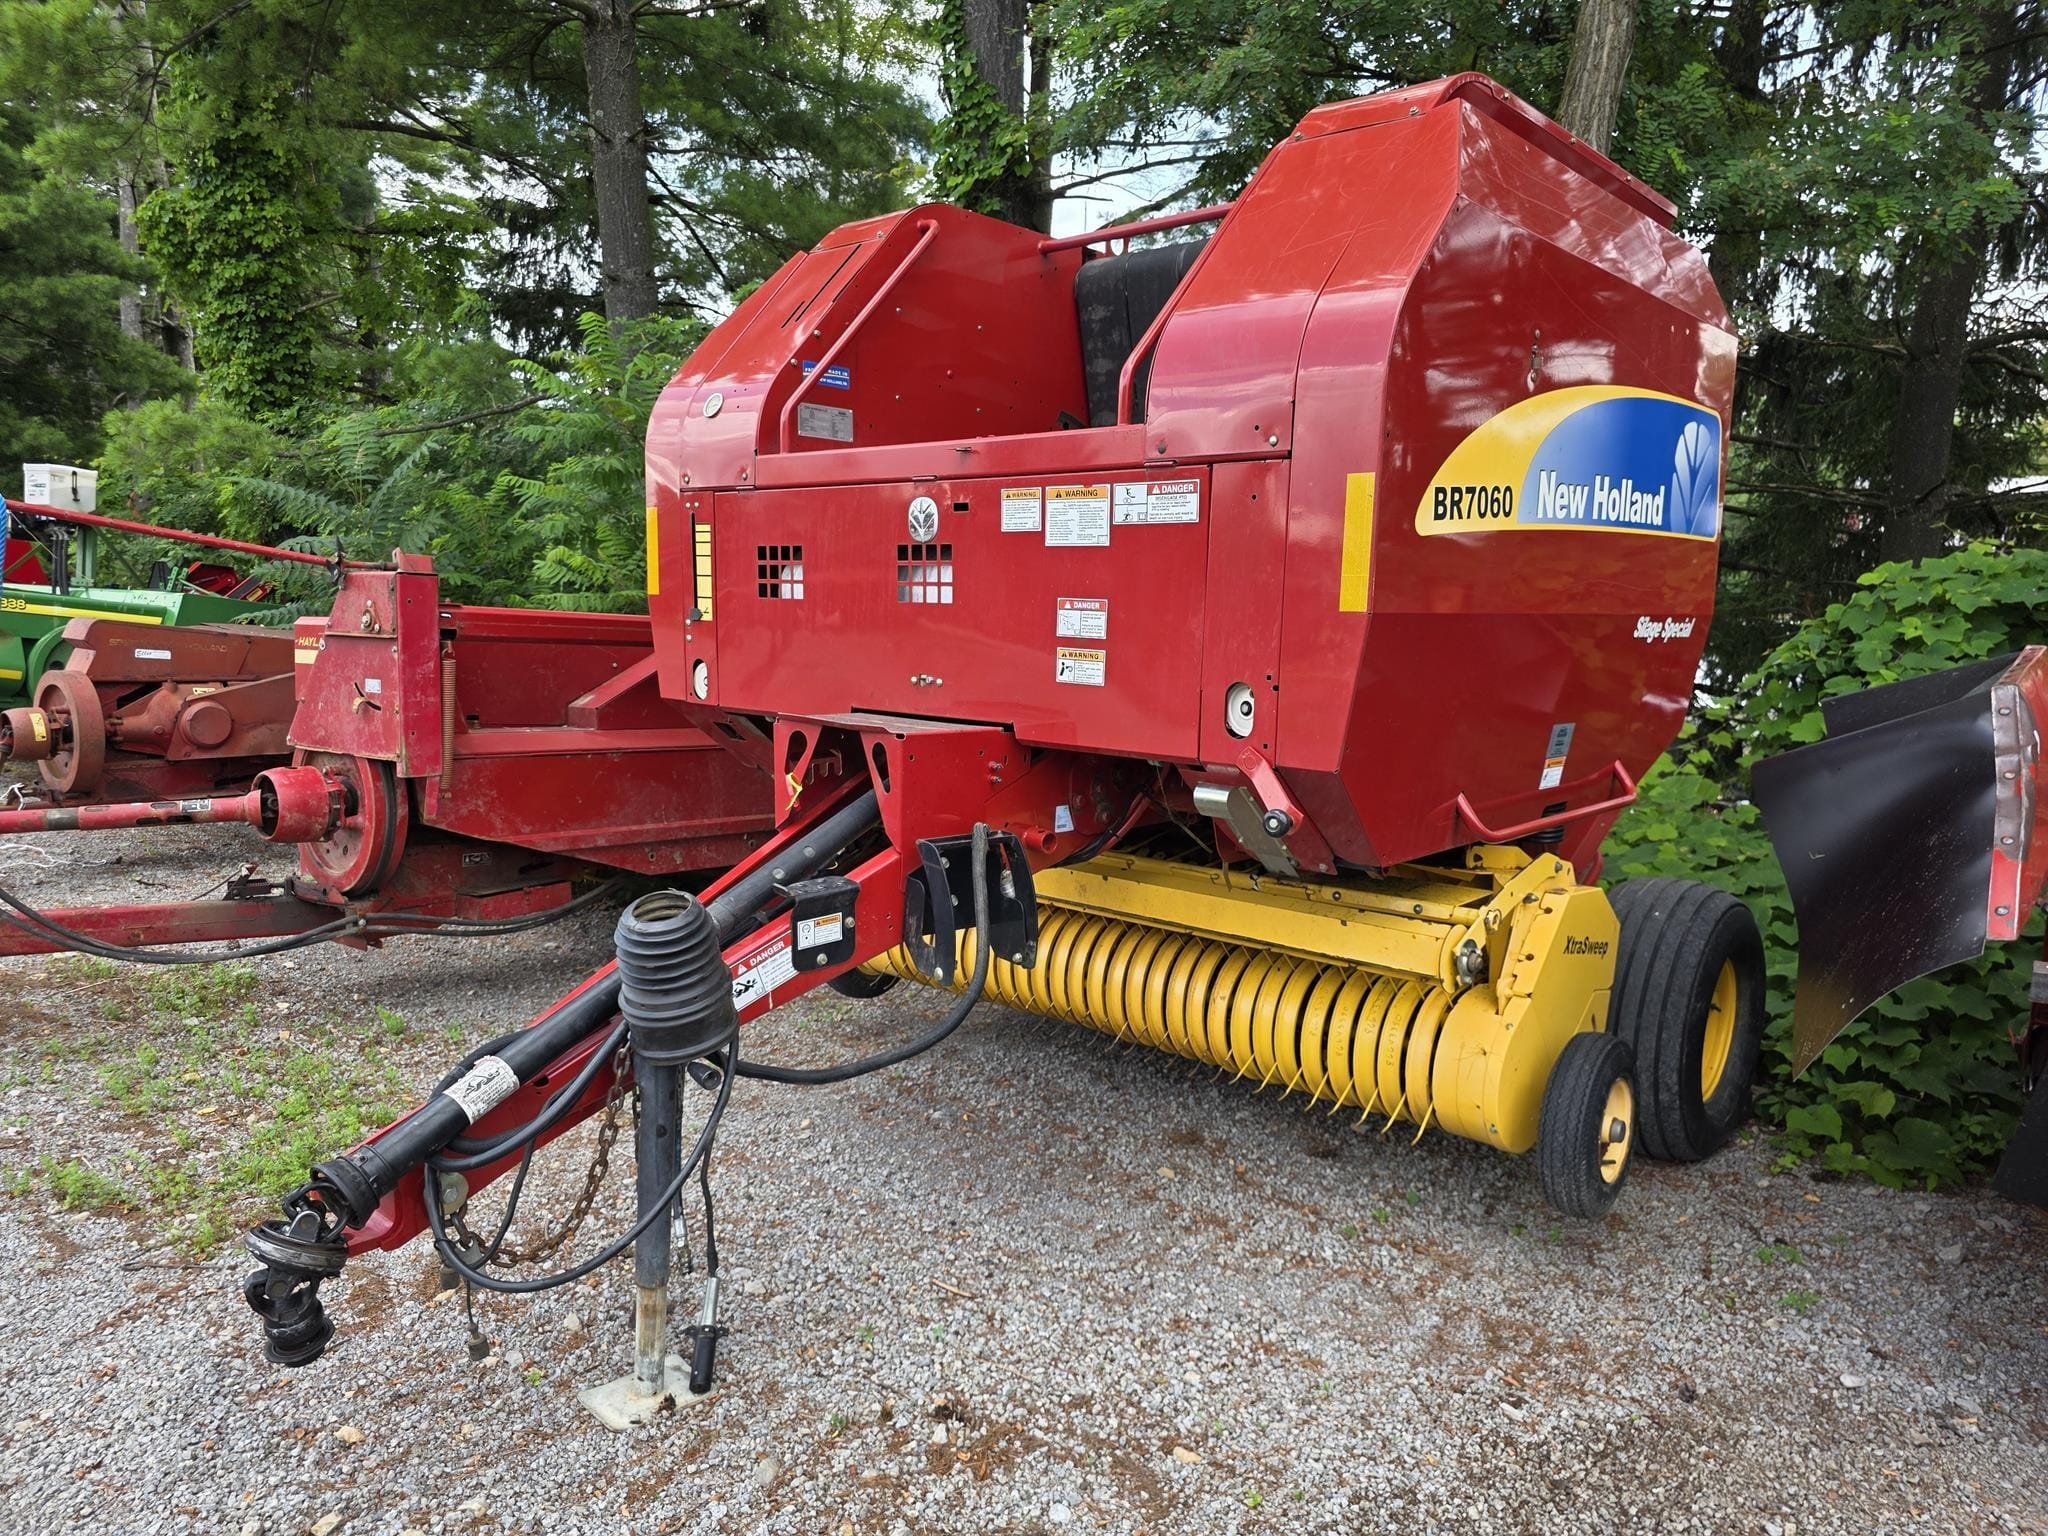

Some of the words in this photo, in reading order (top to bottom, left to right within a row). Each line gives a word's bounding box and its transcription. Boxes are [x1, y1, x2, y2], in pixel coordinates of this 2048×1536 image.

[1064, 489, 1098, 497] WARNING
[1161, 484, 1194, 494] DANGER
[1537, 469, 1589, 519] New
[1591, 474, 1666, 526] Holland
[1433, 485, 1513, 521] BR7060
[1073, 601, 1100, 609] DANGER
[1633, 615, 1663, 643] Silage
[1661, 616, 1696, 643] Special
[298, 636, 319, 647] HAYL
[1067, 651, 1099, 660] WARNING
[749, 940, 785, 967] DANGER
[1562, 935, 1609, 960] XtraSweep
